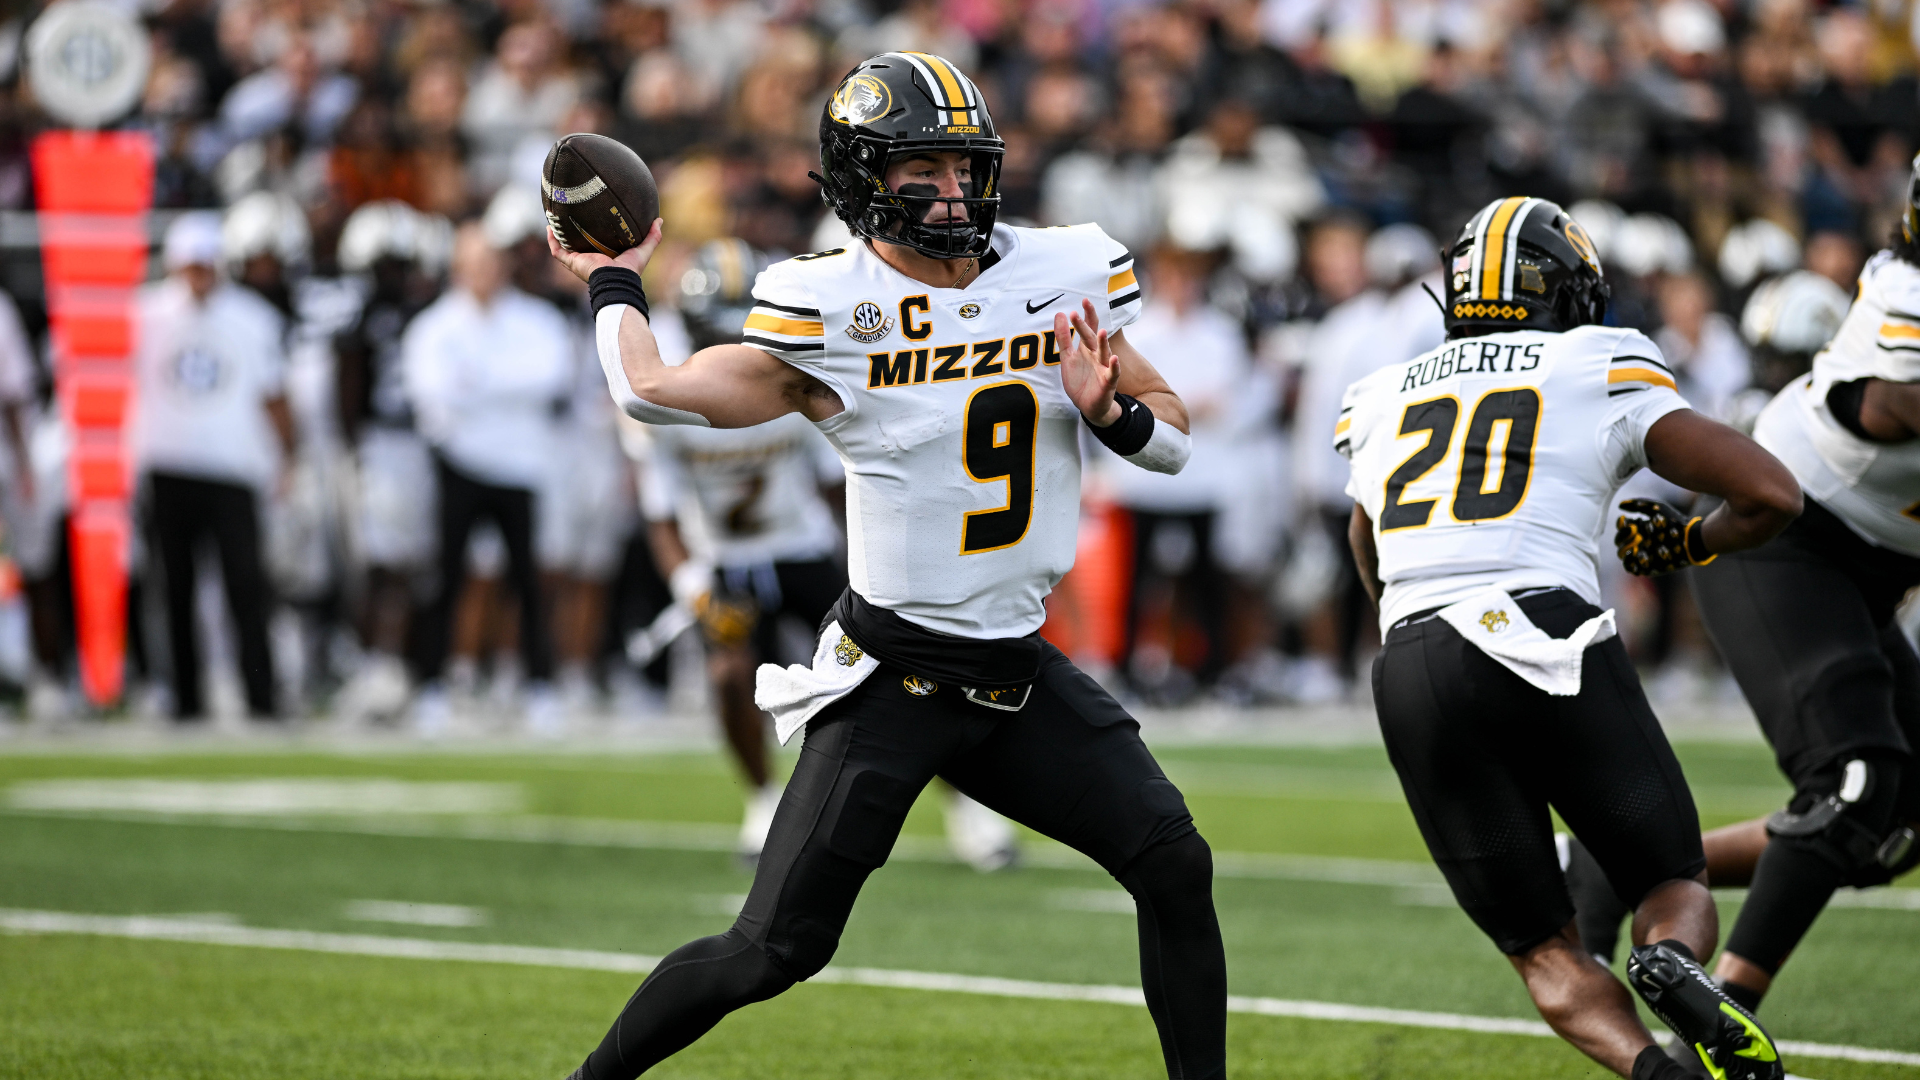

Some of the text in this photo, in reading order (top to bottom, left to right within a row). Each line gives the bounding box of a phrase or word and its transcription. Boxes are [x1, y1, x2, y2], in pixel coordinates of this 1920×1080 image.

[946, 125, 980, 134] MIZZOU
[852, 324, 890, 342] GRADUATE
[855, 302, 880, 328] SEC
[898, 294, 933, 342] C
[1400, 341, 1544, 393] ROBERTS
[959, 379, 1040, 556] 9
[1379, 385, 1544, 536] 20
